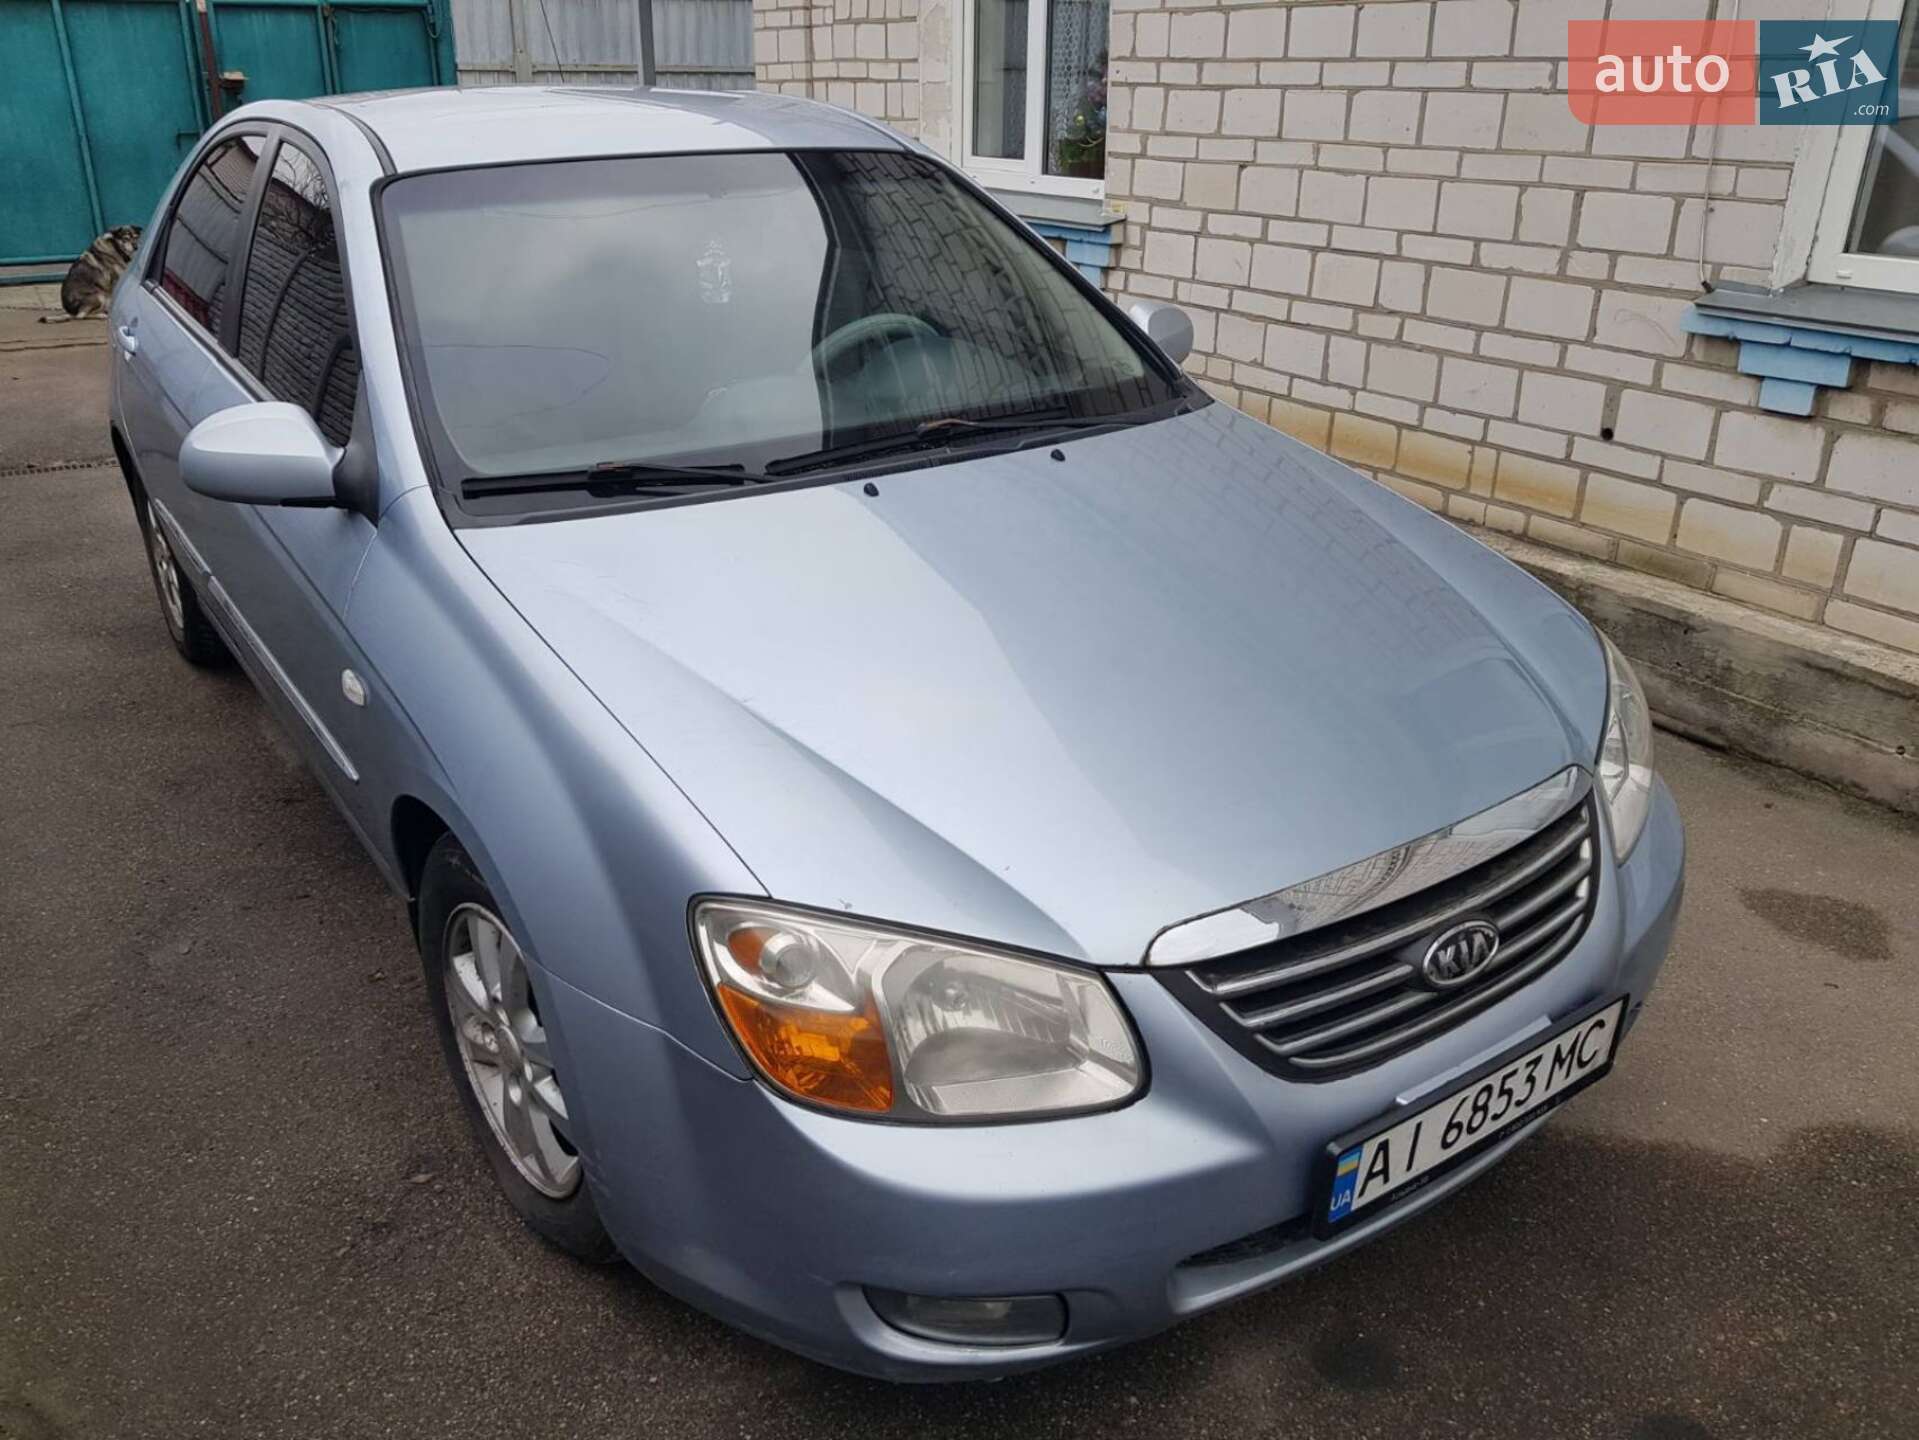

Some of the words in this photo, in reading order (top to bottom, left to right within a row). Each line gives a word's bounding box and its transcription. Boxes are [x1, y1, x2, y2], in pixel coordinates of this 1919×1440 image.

[1436, 931, 1493, 974] KIA
[1357, 1121, 1423, 1198] AI
[1440, 1054, 1544, 1150] 6853
[1545, 1019, 1606, 1092] MC
[1329, 1190, 1351, 1211] UA
